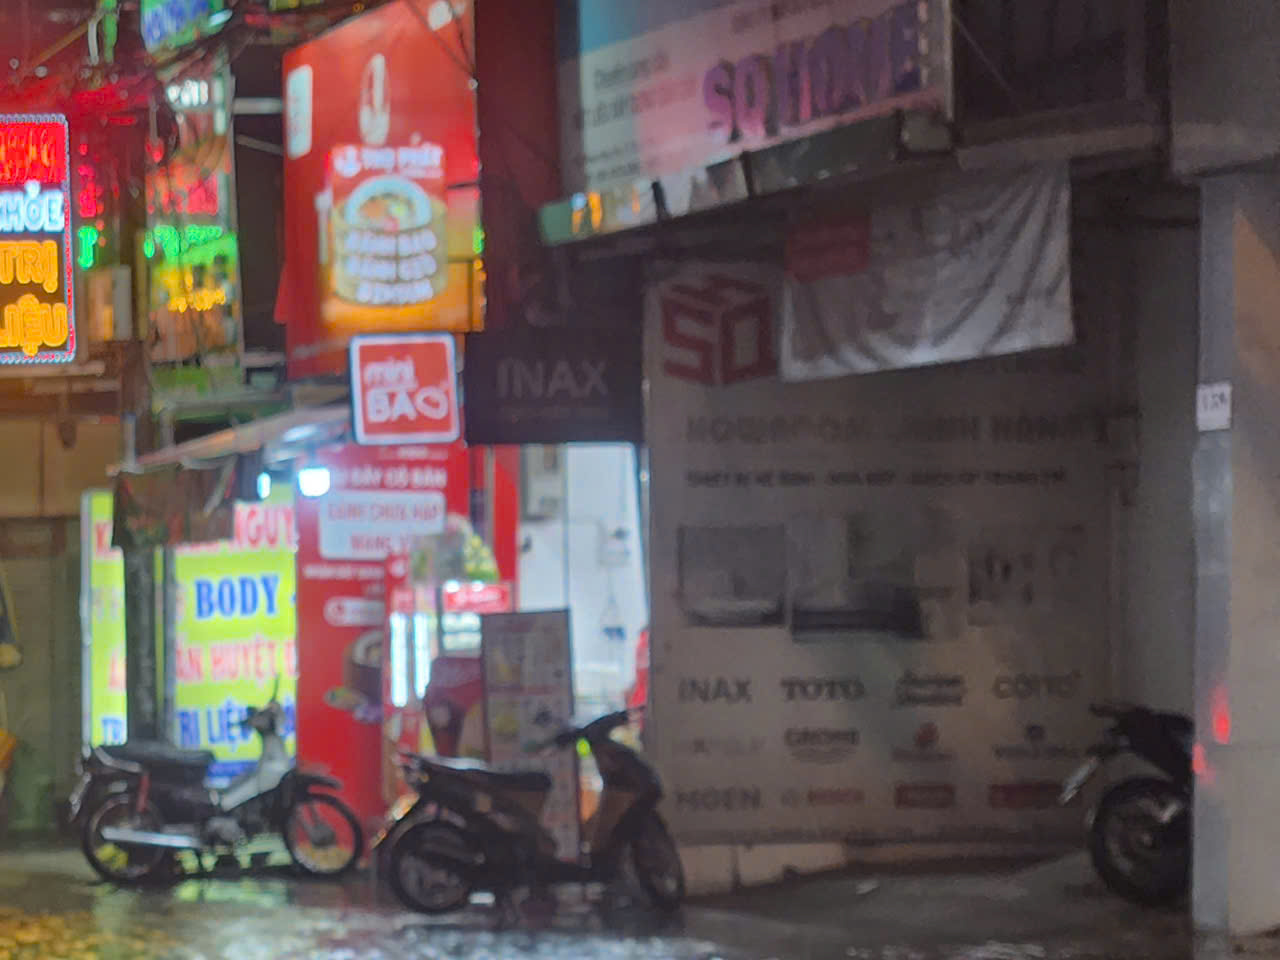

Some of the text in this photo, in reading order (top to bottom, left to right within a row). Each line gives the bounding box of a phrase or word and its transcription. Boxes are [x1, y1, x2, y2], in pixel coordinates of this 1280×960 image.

[497, 358, 608, 398] INAX
[195, 574, 279, 620] BODY
[679, 675, 753, 703] INAX
[781, 675, 866, 702] TOTO
